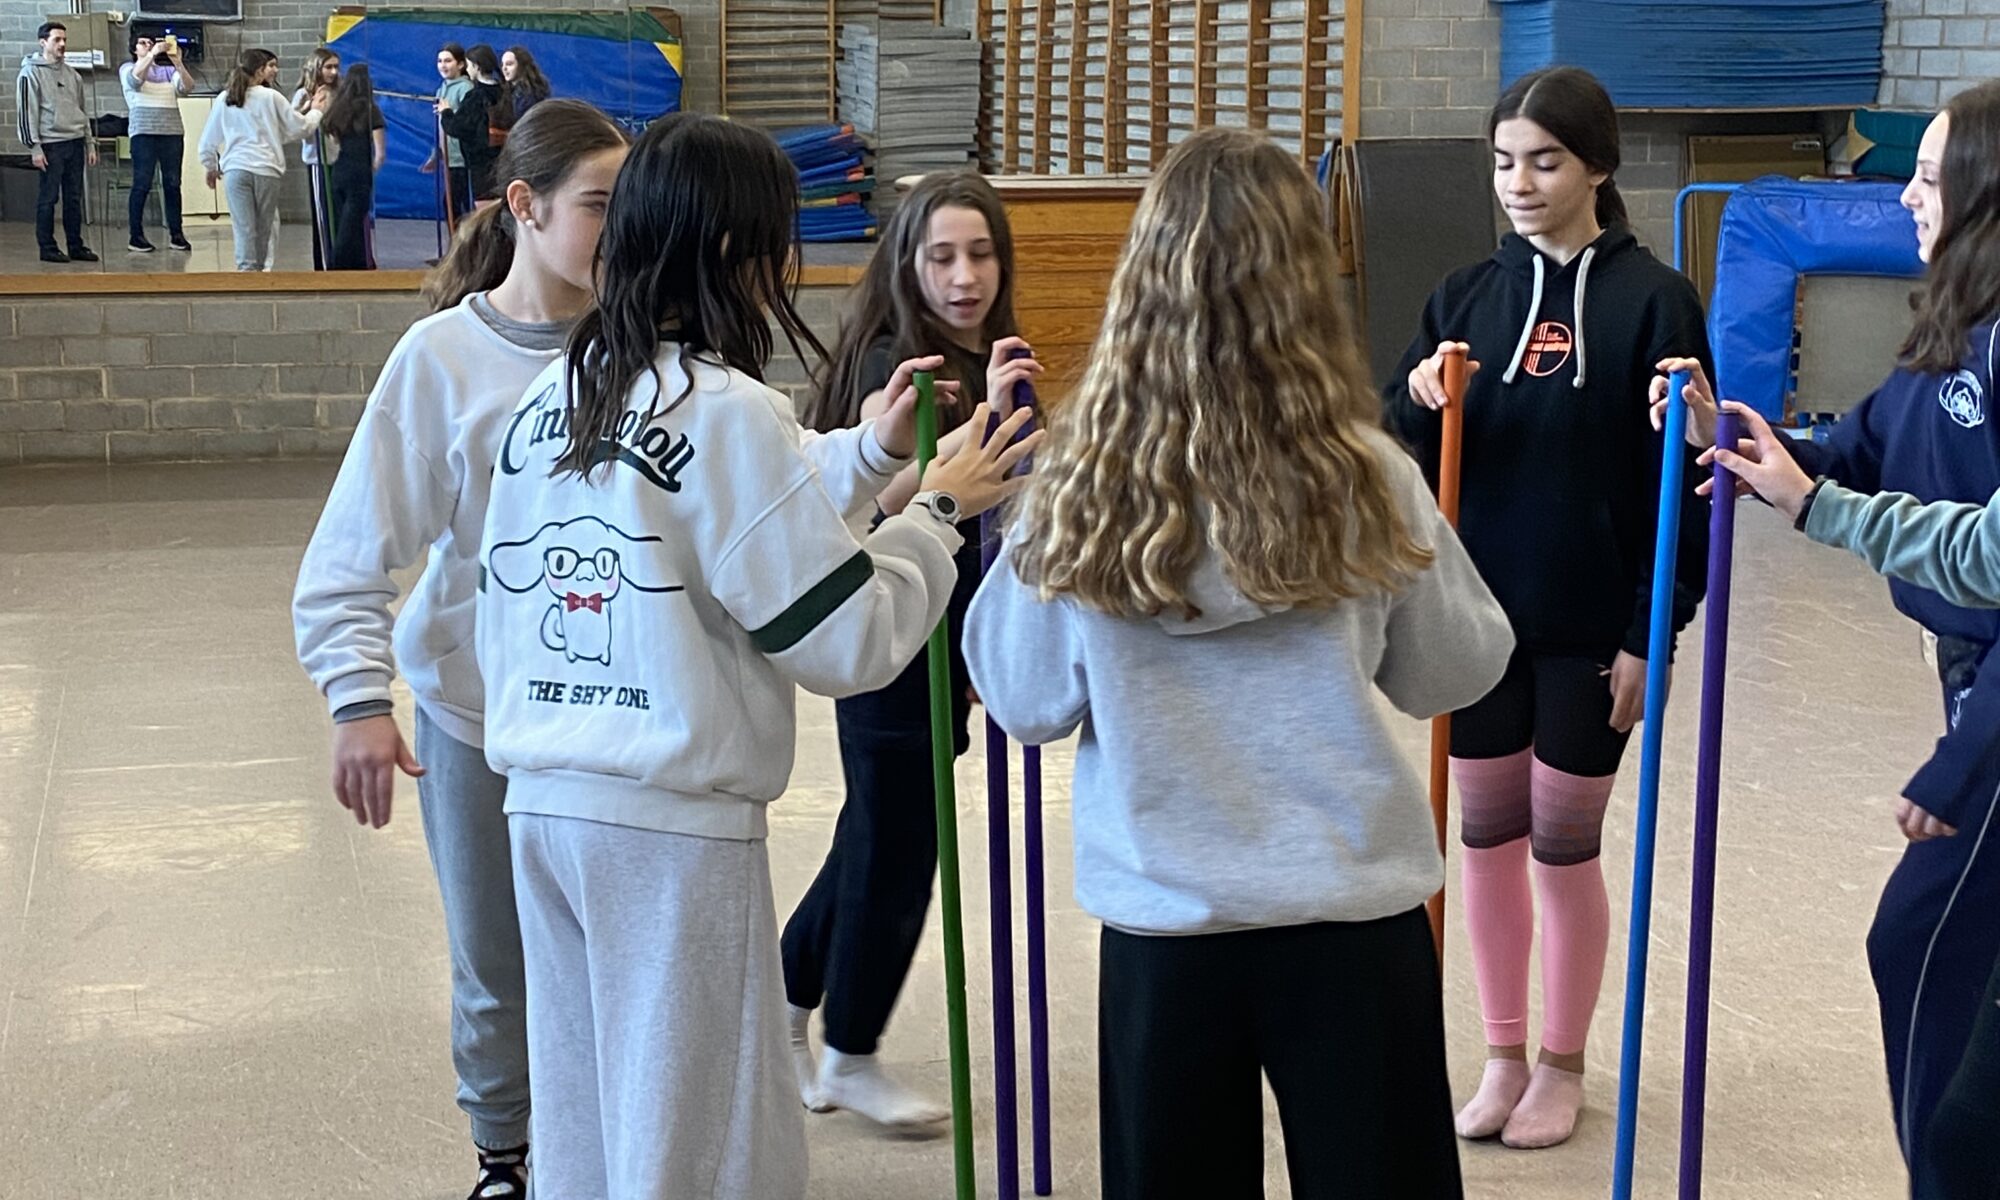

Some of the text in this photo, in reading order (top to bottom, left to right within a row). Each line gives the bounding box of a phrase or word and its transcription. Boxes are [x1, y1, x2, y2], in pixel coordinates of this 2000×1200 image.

[528, 680, 650, 710] THE SHY ONE
